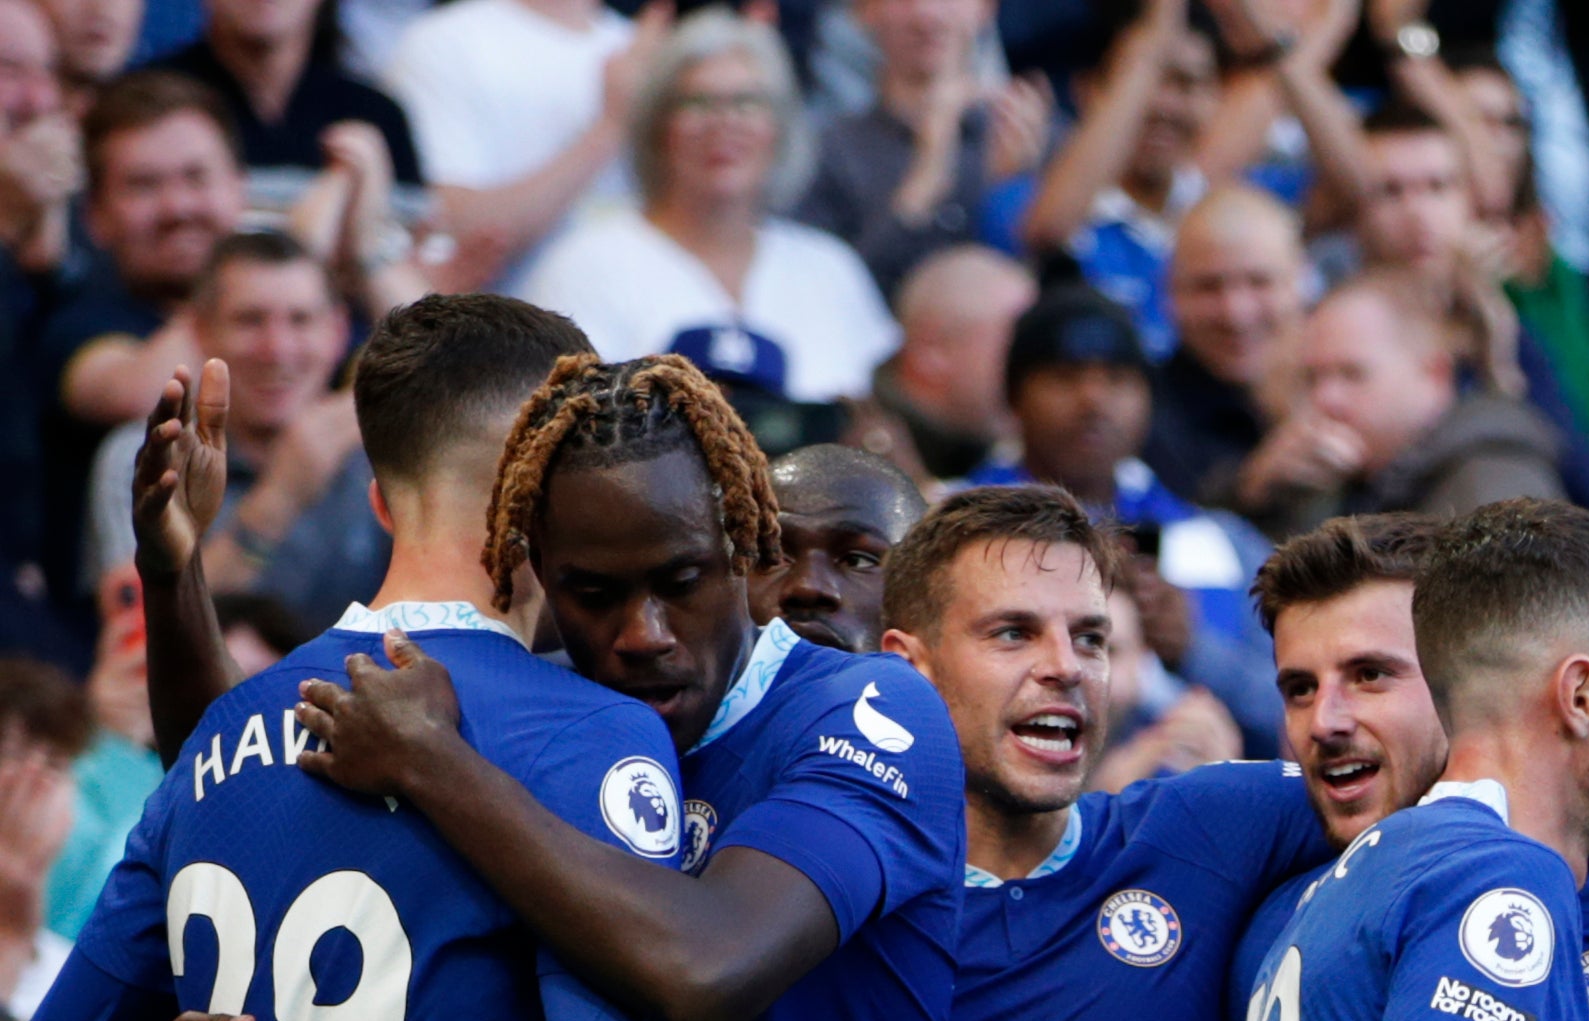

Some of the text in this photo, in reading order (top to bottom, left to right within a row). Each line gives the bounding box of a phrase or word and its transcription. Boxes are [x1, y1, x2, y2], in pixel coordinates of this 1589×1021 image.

[819, 735, 908, 799] WhaleFin
[1104, 892, 1151, 917] CHELSEA
[1436, 976, 1471, 1001] No
